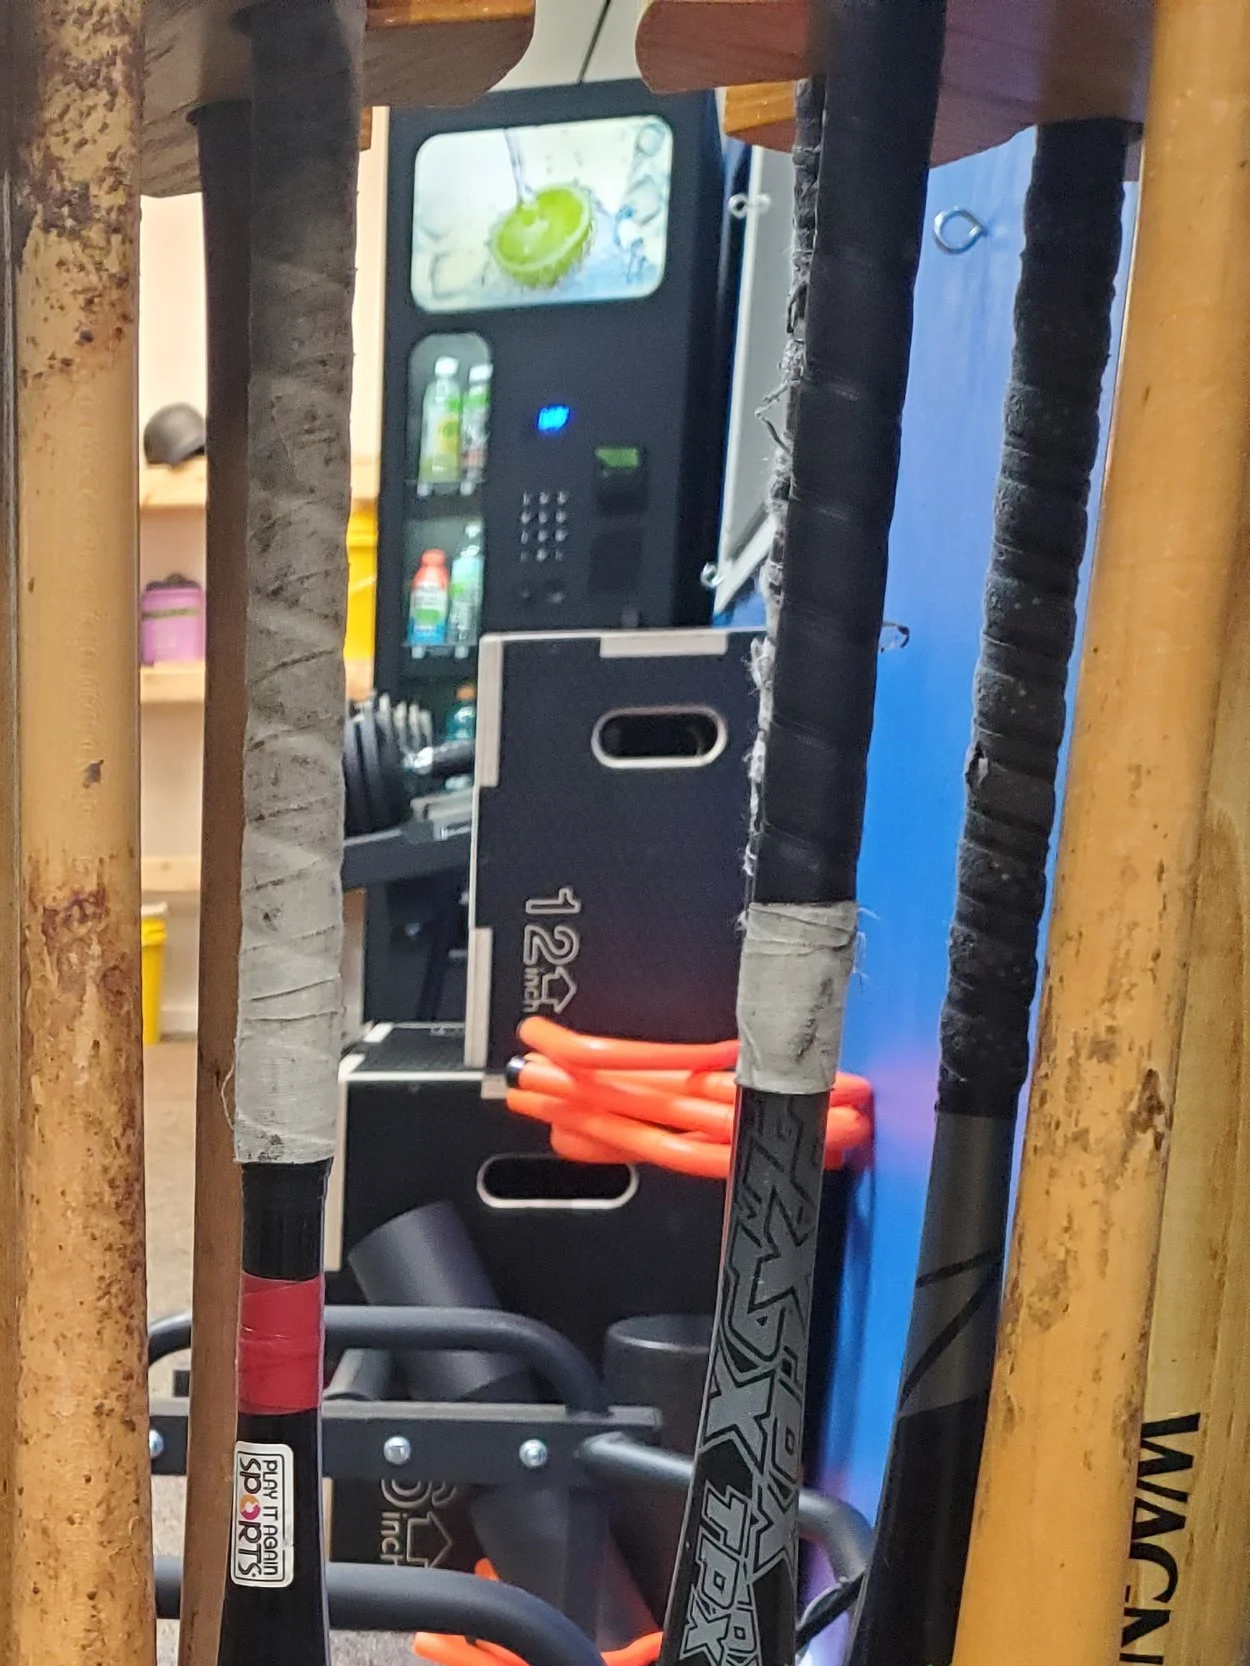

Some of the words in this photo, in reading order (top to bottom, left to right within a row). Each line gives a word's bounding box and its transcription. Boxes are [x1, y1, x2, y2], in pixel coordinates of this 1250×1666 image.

[523, 888, 581, 966] 12
[263, 1459, 278, 1500] PLAY
[263, 1506, 278, 1521] IT
